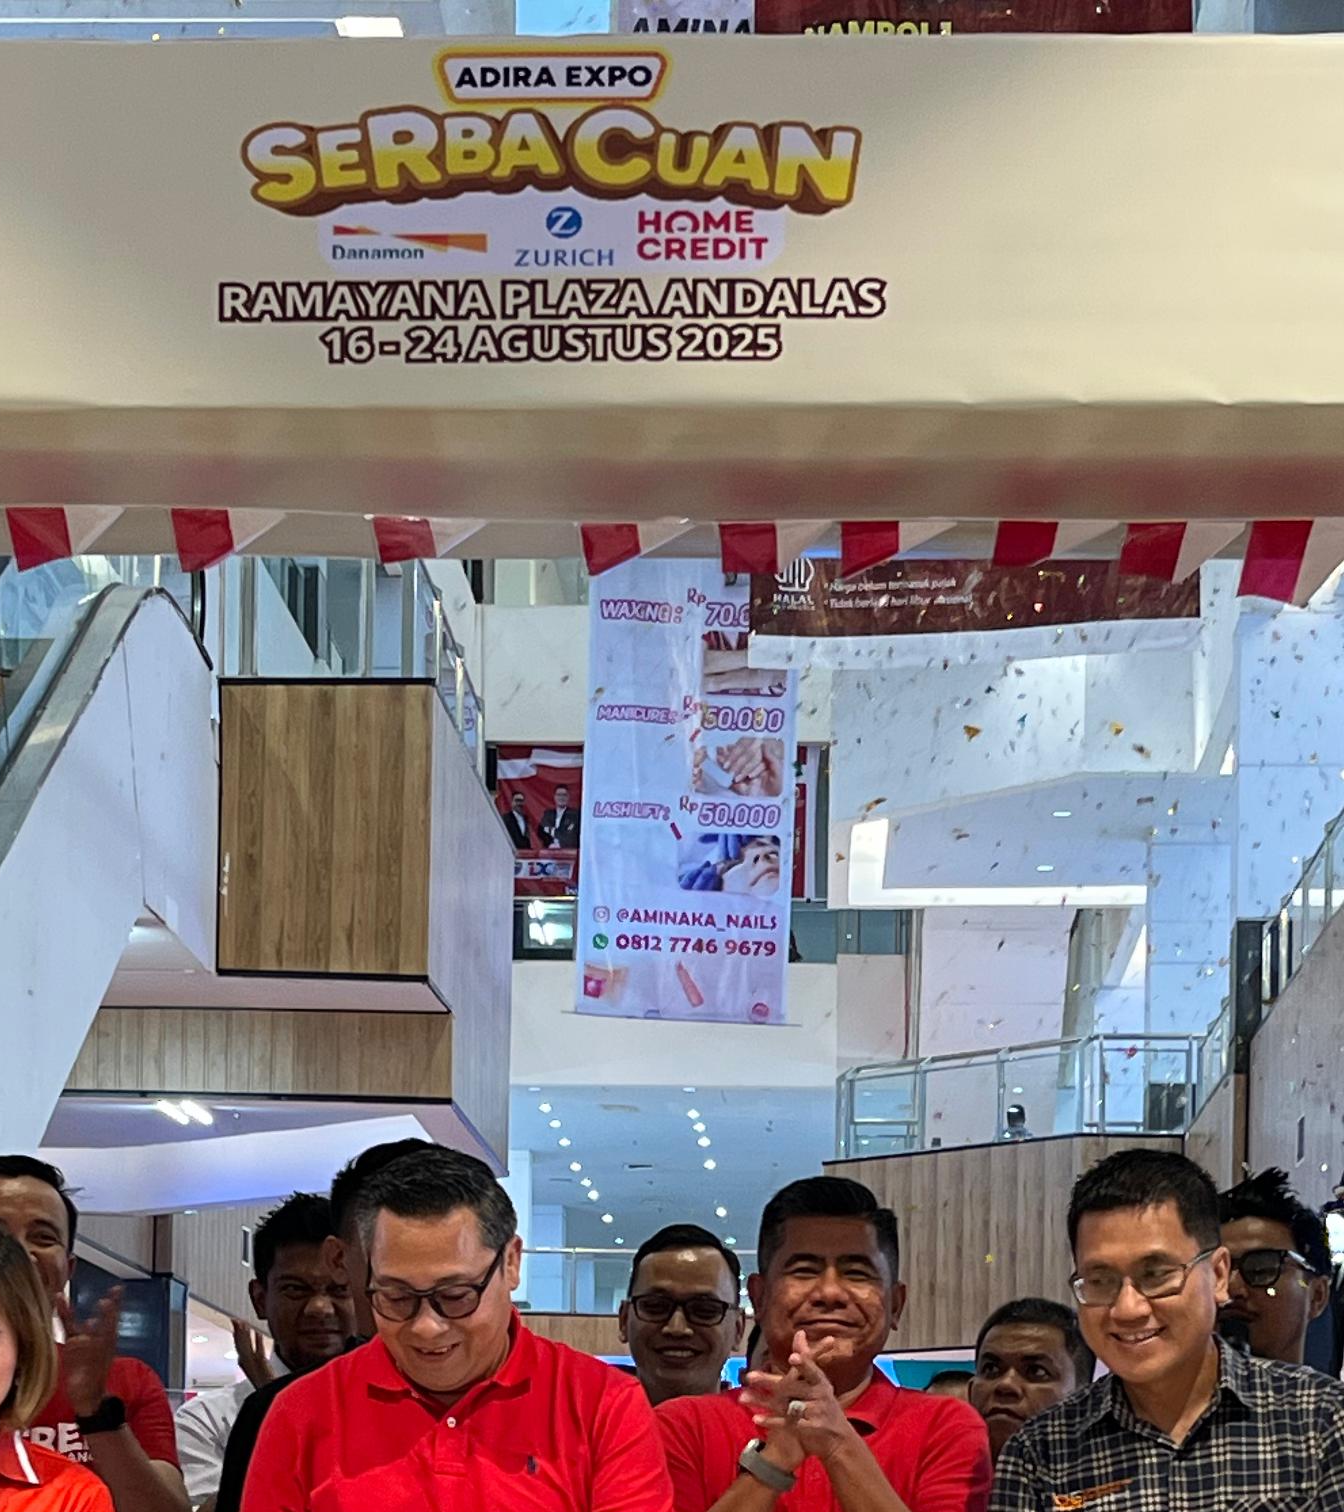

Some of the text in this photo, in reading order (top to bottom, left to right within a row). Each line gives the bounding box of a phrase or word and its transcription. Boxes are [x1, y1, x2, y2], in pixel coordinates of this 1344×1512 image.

[455, 64, 654, 89] ADIRA EXPO
[637, 209, 755, 234] HOME
[331, 244, 425, 261] Danamon
[514, 248, 615, 267] ZURICH
[637, 236, 769, 262] CREDIT
[219, 277, 886, 323] RAMAYANA PLAZA ANDALAS
[320, 326, 371, 363] 16
[406, 325, 461, 362] 24
[467, 323, 668, 361] AGUSTUS
[680, 322, 782, 360] 2025
[698, 803, 781, 828] 50.000
[616, 907, 778, 932] @AMINAKA_NAILS
[615, 933, 777, 957] 0812 7746 9679
